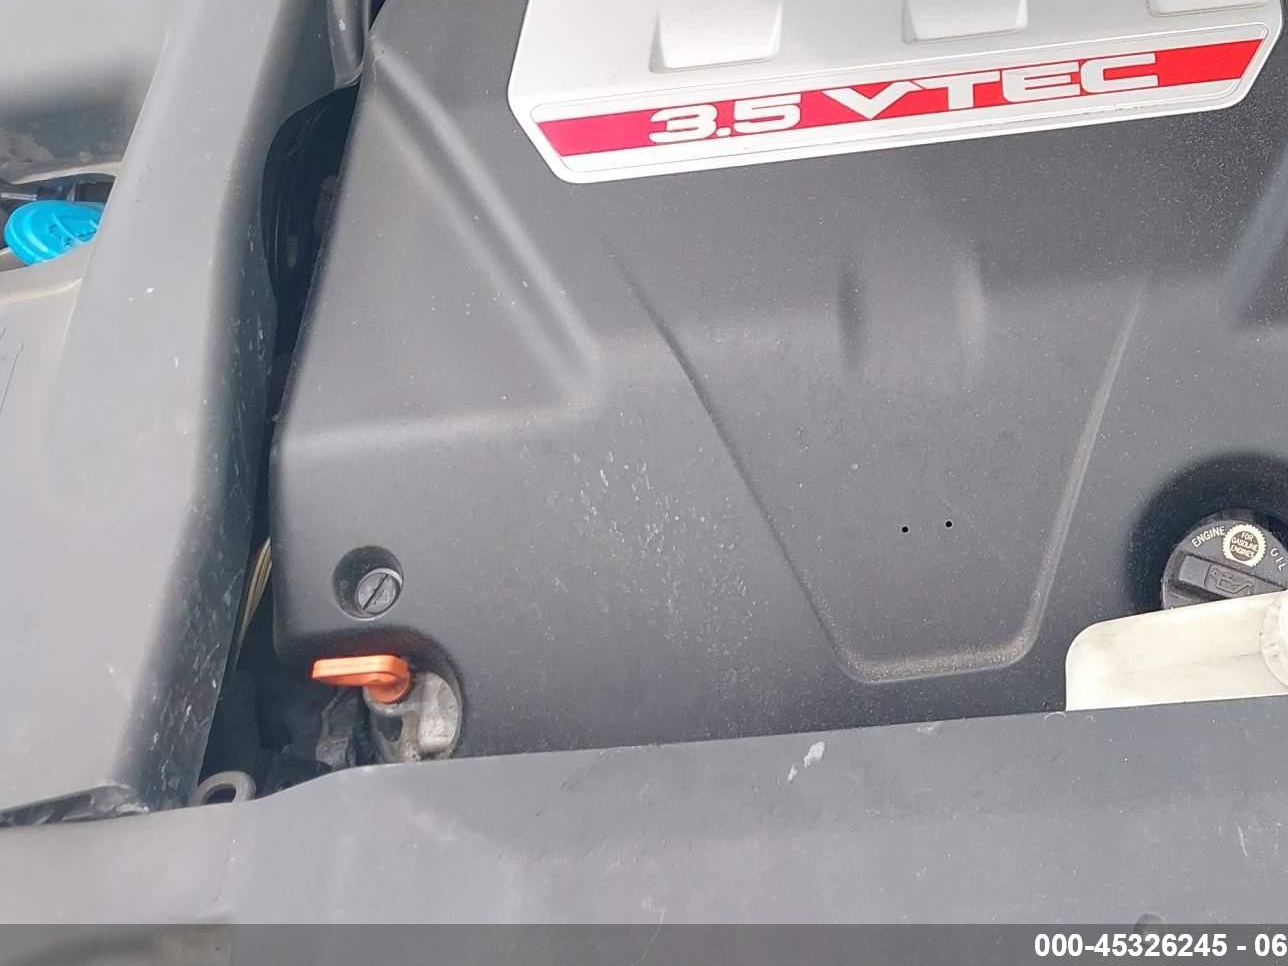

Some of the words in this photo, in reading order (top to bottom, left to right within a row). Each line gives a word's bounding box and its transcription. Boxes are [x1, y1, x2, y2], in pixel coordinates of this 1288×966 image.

[648, 95, 801, 145] 3.5
[821, 52, 1157, 120] VTEC
[1241, 532, 1254, 541] FOR
[1191, 526, 1226, 547] ENGINE
[1270, 548, 1288, 571] OIL
[1231, 537, 1258, 551] GASOLINE
[1231, 546, 1255, 557] ENGINES
